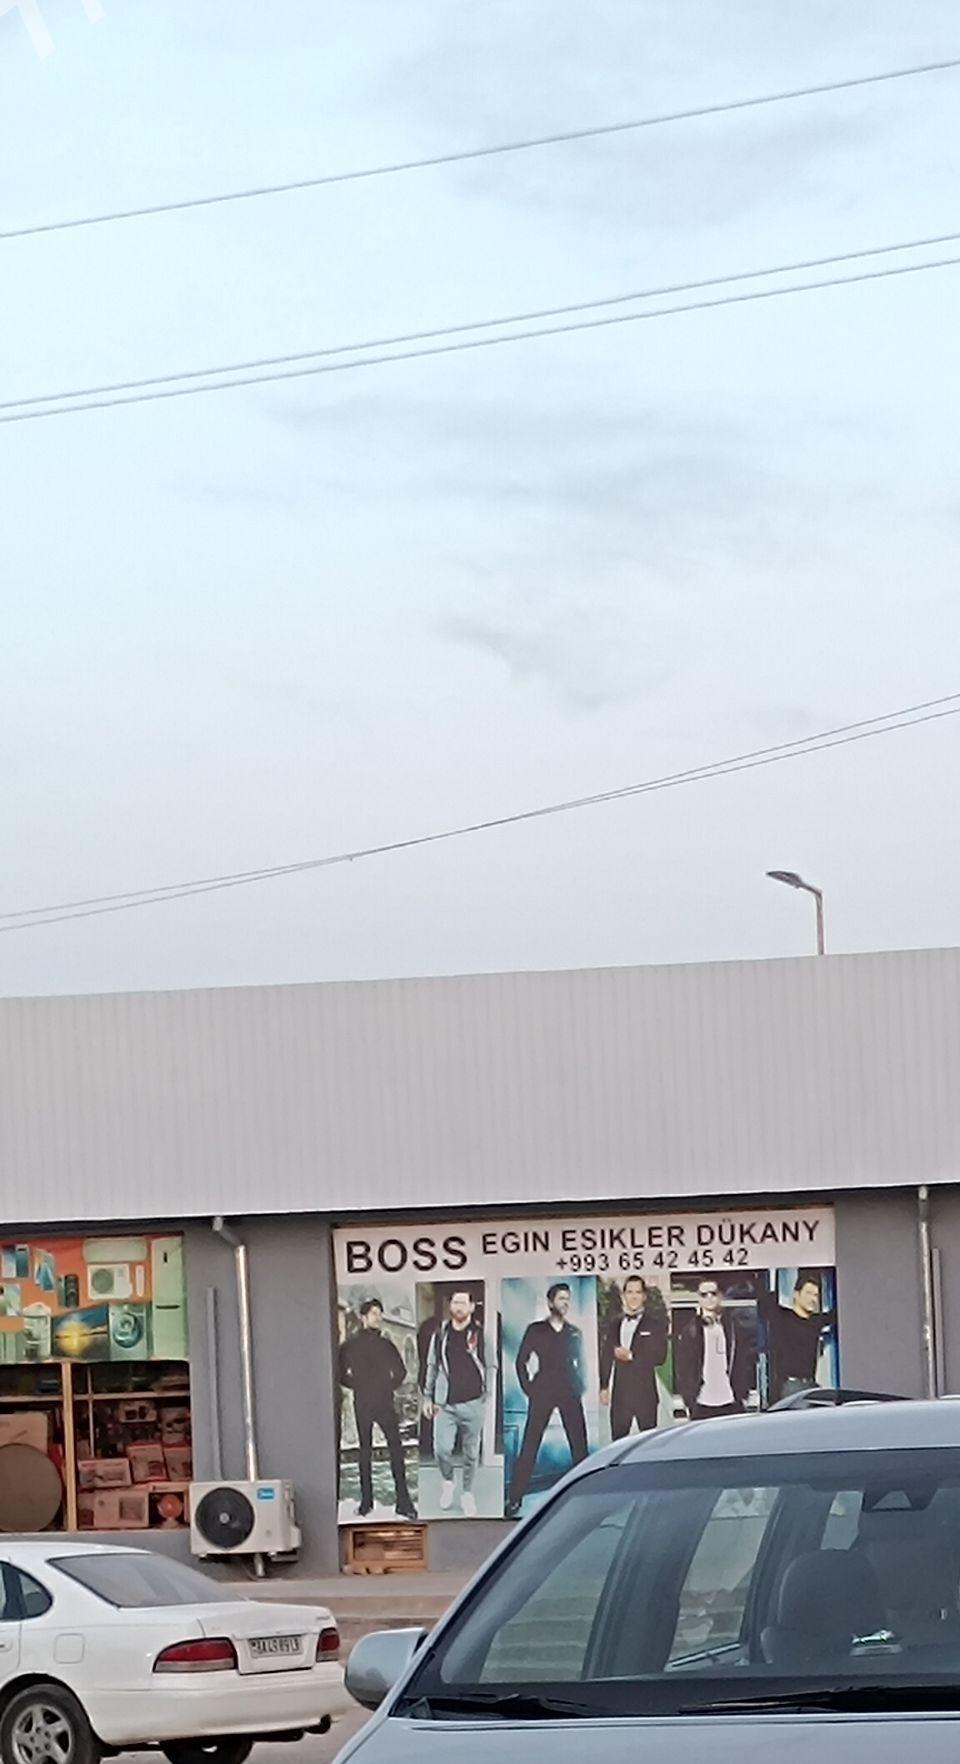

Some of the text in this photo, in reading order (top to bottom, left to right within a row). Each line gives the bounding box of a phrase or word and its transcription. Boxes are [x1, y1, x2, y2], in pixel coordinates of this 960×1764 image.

[346, 1218, 820, 1273] BOSS EGIN ESIKLER DÜKANY
[556, 1248, 748, 1272] +993 65 42 45 42
